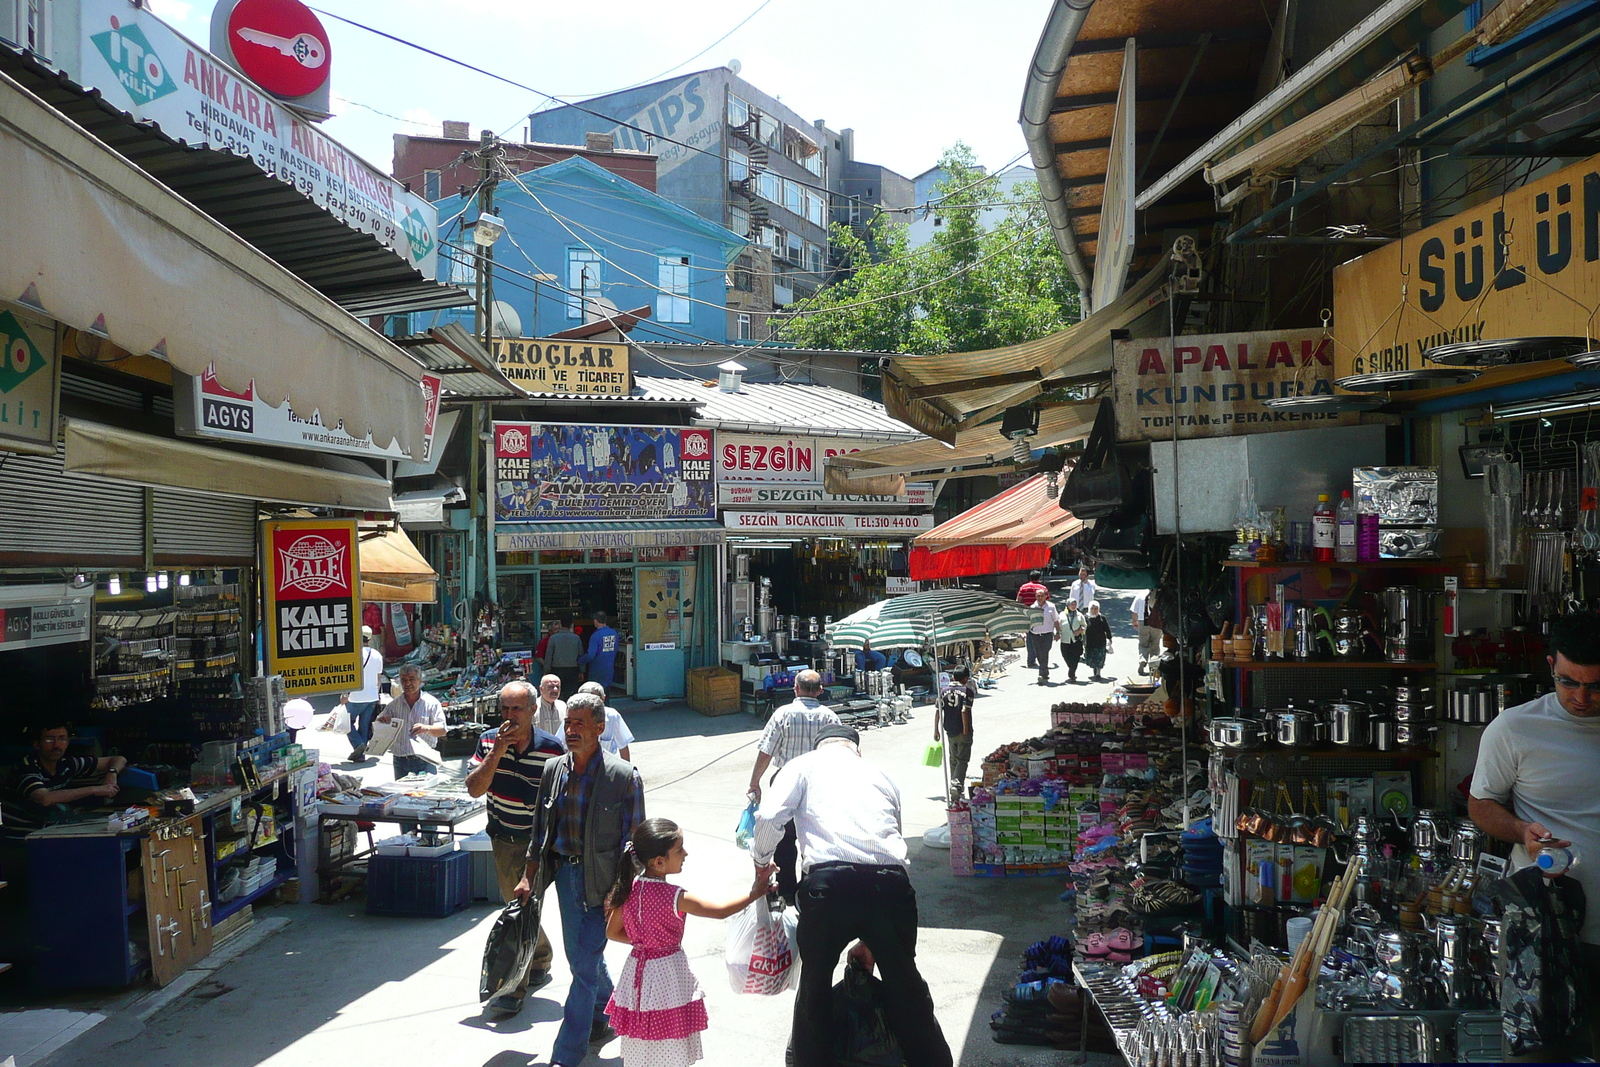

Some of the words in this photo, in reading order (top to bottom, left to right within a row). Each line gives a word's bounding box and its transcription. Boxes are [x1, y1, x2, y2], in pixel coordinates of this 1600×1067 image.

[184, 48, 278, 139] ANKARA
[612, 77, 705, 153] ILIPS
[262, 140, 275, 155] ve
[280, 147, 322, 182] MASTER
[326, 175, 343, 195] KEY
[258, 153, 277, 173] 311
[299, 177, 314, 194] 39
[349, 206, 366, 223] 310
[370, 218, 381, 231] 10
[384, 227, 397, 241] 92
[1138, 338, 1333, 375] APALAK
[553, 370, 568, 381] VE
[577, 369, 625, 383] TİCARET
[576, 384, 588, 392] 311
[1136, 379, 1335, 405] KUNDURA
[0, 401, 40, 428] LİT
[208, 403, 251, 430] AGYS
[498, 458, 530, 469] KALE
[682, 460, 710, 471] KALE
[722, 440, 813, 473] SEZGİN
[541, 482, 676, 495] ANKARALI
[757, 489, 823, 502] SEZGİN
[739, 513, 778, 526] SEZGİN
[577, 532, 634, 546] ANAHTARCI
[284, 553, 341, 583] KALE
[7, 616, 30, 632] AGYS
[281, 604, 348, 628] KALE
[298, 665, 316, 676] KİLİT
[318, 662, 355, 674] ÜRÜNLERİ
[285, 678, 317, 689] URADA
[320, 674, 355, 686] SATILIR
